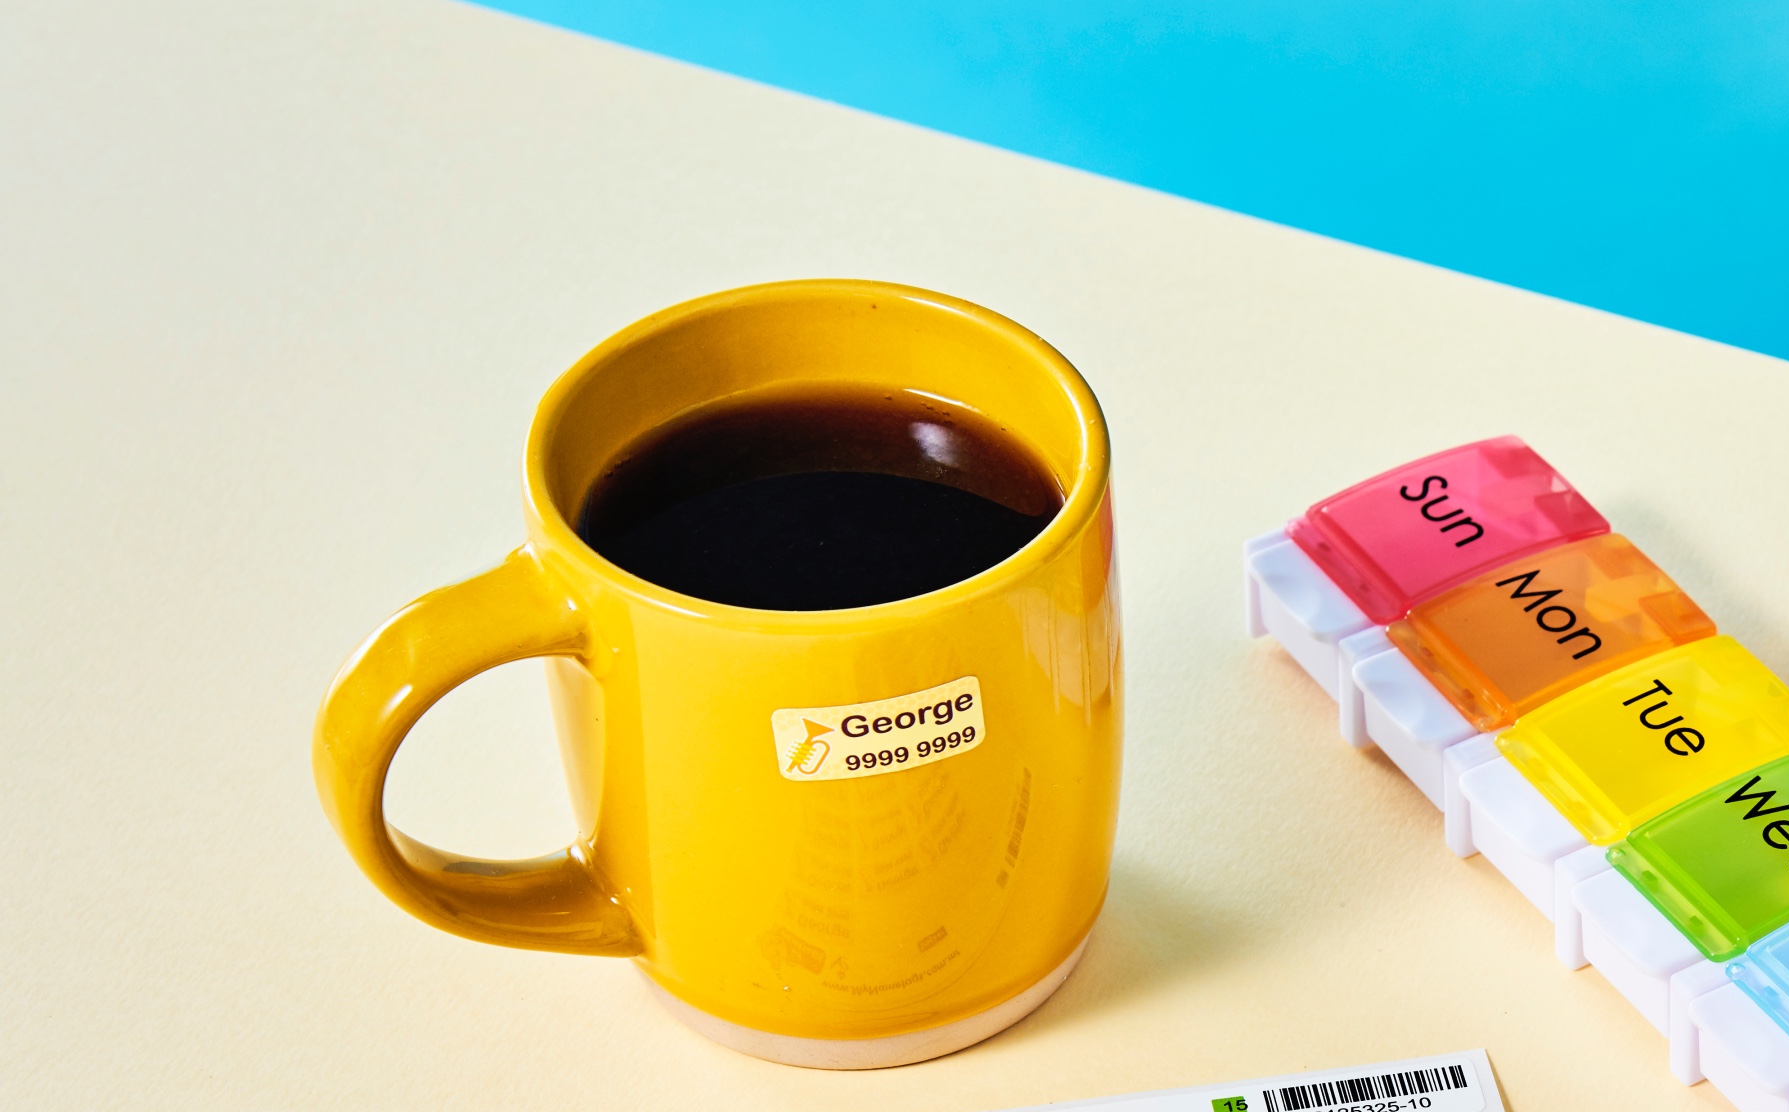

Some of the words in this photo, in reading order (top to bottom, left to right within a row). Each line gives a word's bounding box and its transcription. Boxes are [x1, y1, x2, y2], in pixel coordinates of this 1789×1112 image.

[1400, 475, 1484, 548] Sun
[1495, 569, 1602, 660] Mon
[841, 693, 974, 737] George
[1621, 679, 1705, 756] Tue
[846, 747, 909, 770] 9999
[917, 726, 975, 757] 9999
[1223, 1099, 1249, 1112] 15
